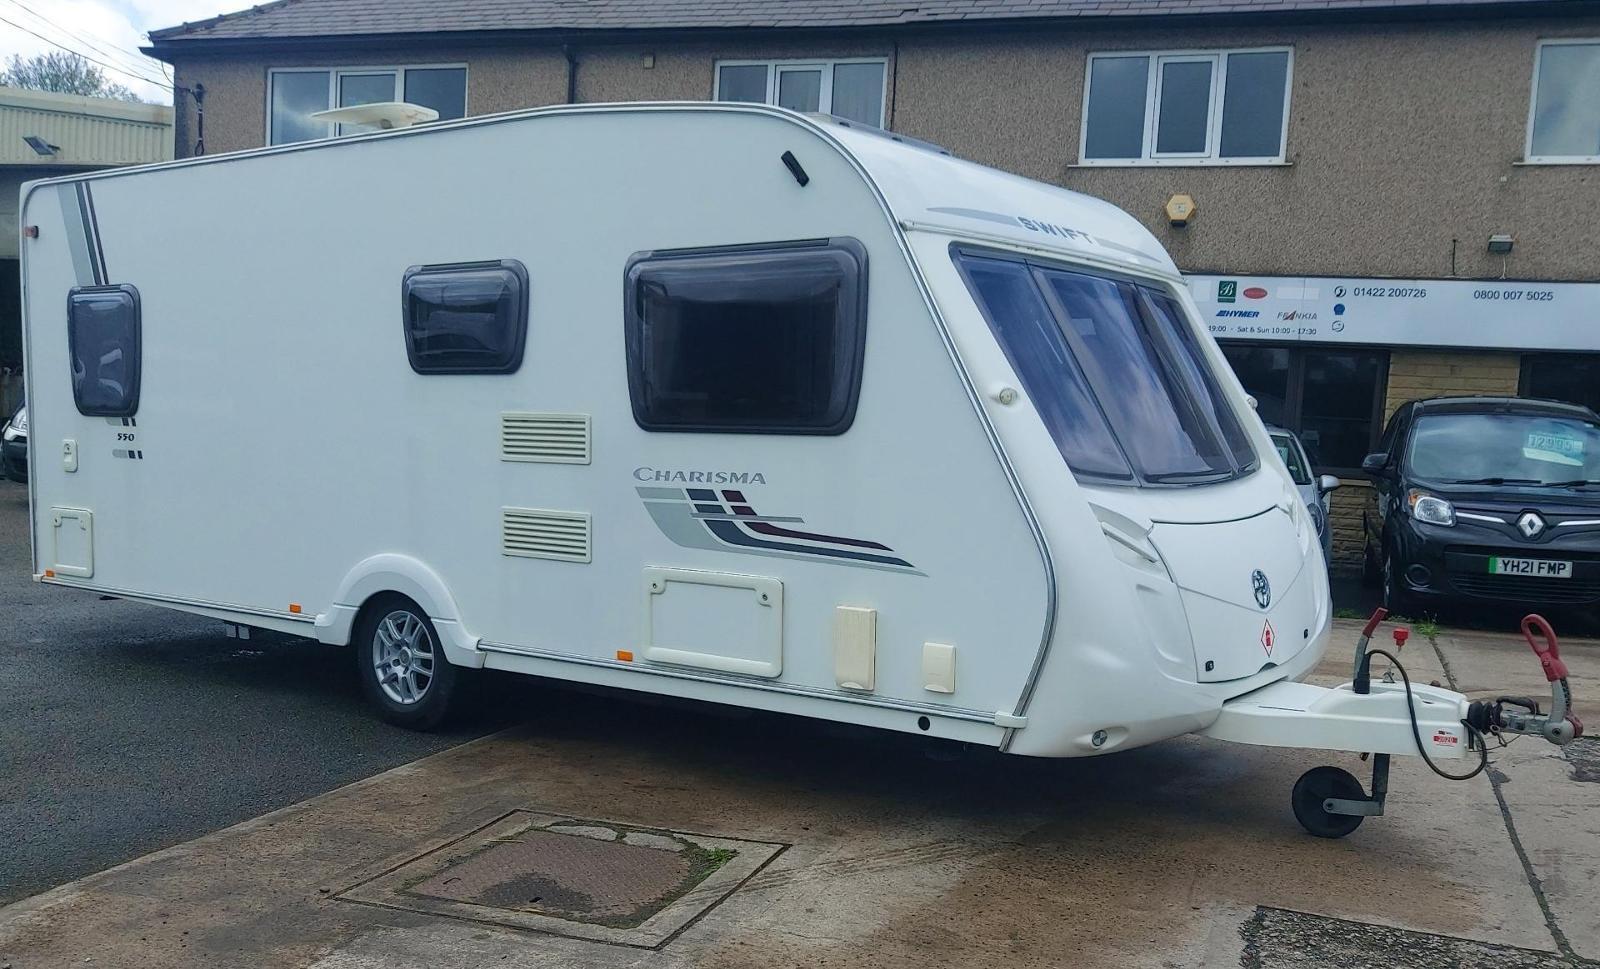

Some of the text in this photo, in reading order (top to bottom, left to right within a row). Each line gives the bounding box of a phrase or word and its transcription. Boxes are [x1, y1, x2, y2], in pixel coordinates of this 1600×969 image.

[1017, 216, 1094, 244] SWIFT
[1353, 287, 1427, 298] 01422 200726
[1473, 290, 1554, 301] 0800 007 5025
[1225, 310, 1260, 318] HYMER
[1277, 311, 1318, 321] FRANKIA
[117, 433, 135, 441] 550
[633, 467, 767, 485] CHARISMA
[1502, 559, 1567, 575] YH21 FMP
